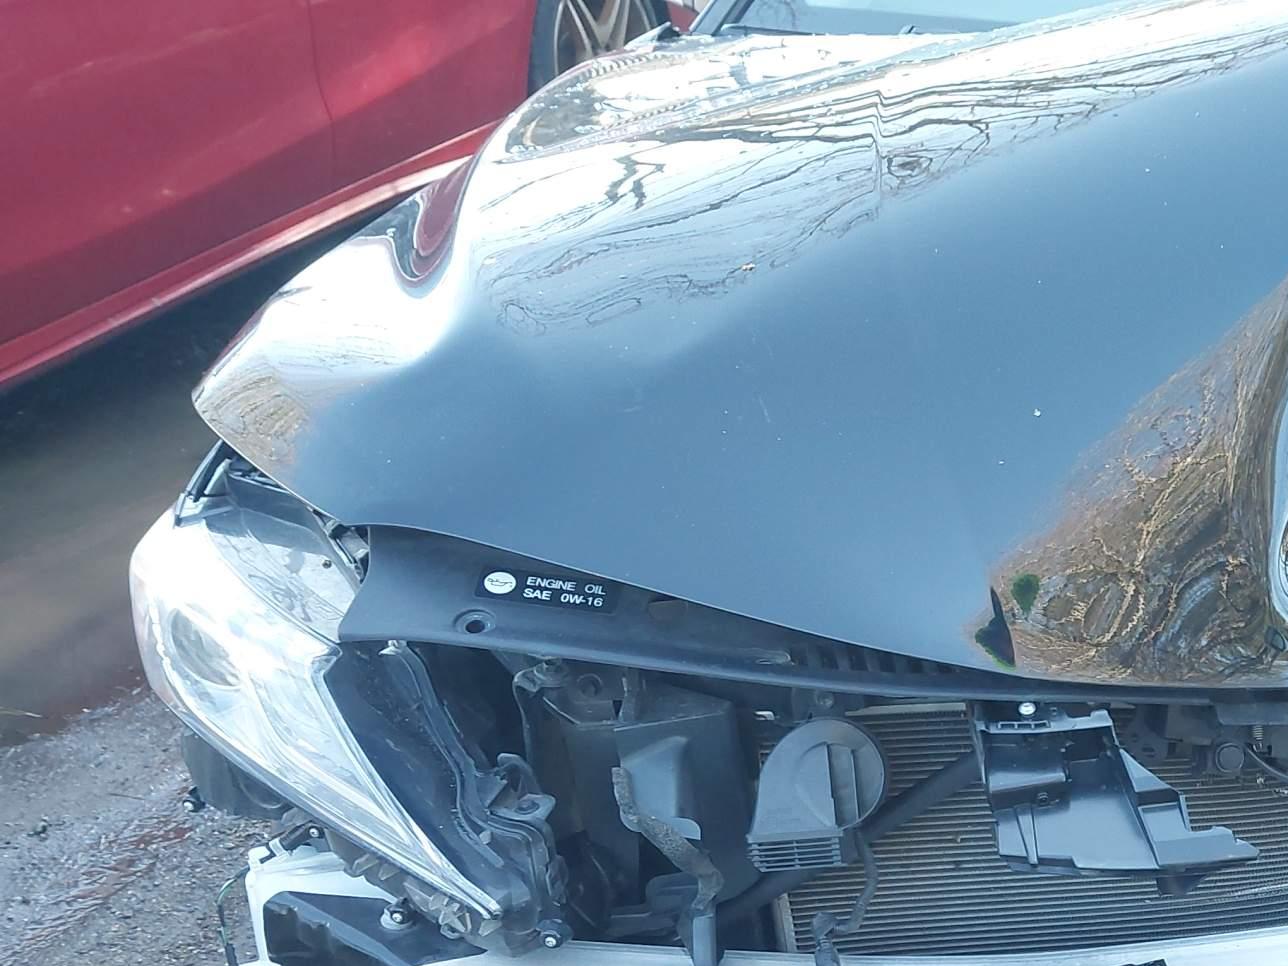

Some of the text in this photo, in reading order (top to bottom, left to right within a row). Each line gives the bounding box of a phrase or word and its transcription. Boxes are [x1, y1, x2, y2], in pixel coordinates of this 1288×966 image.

[526, 576, 606, 595] ENGINE OIL
[522, 588, 604, 607] SAE 0W-16
